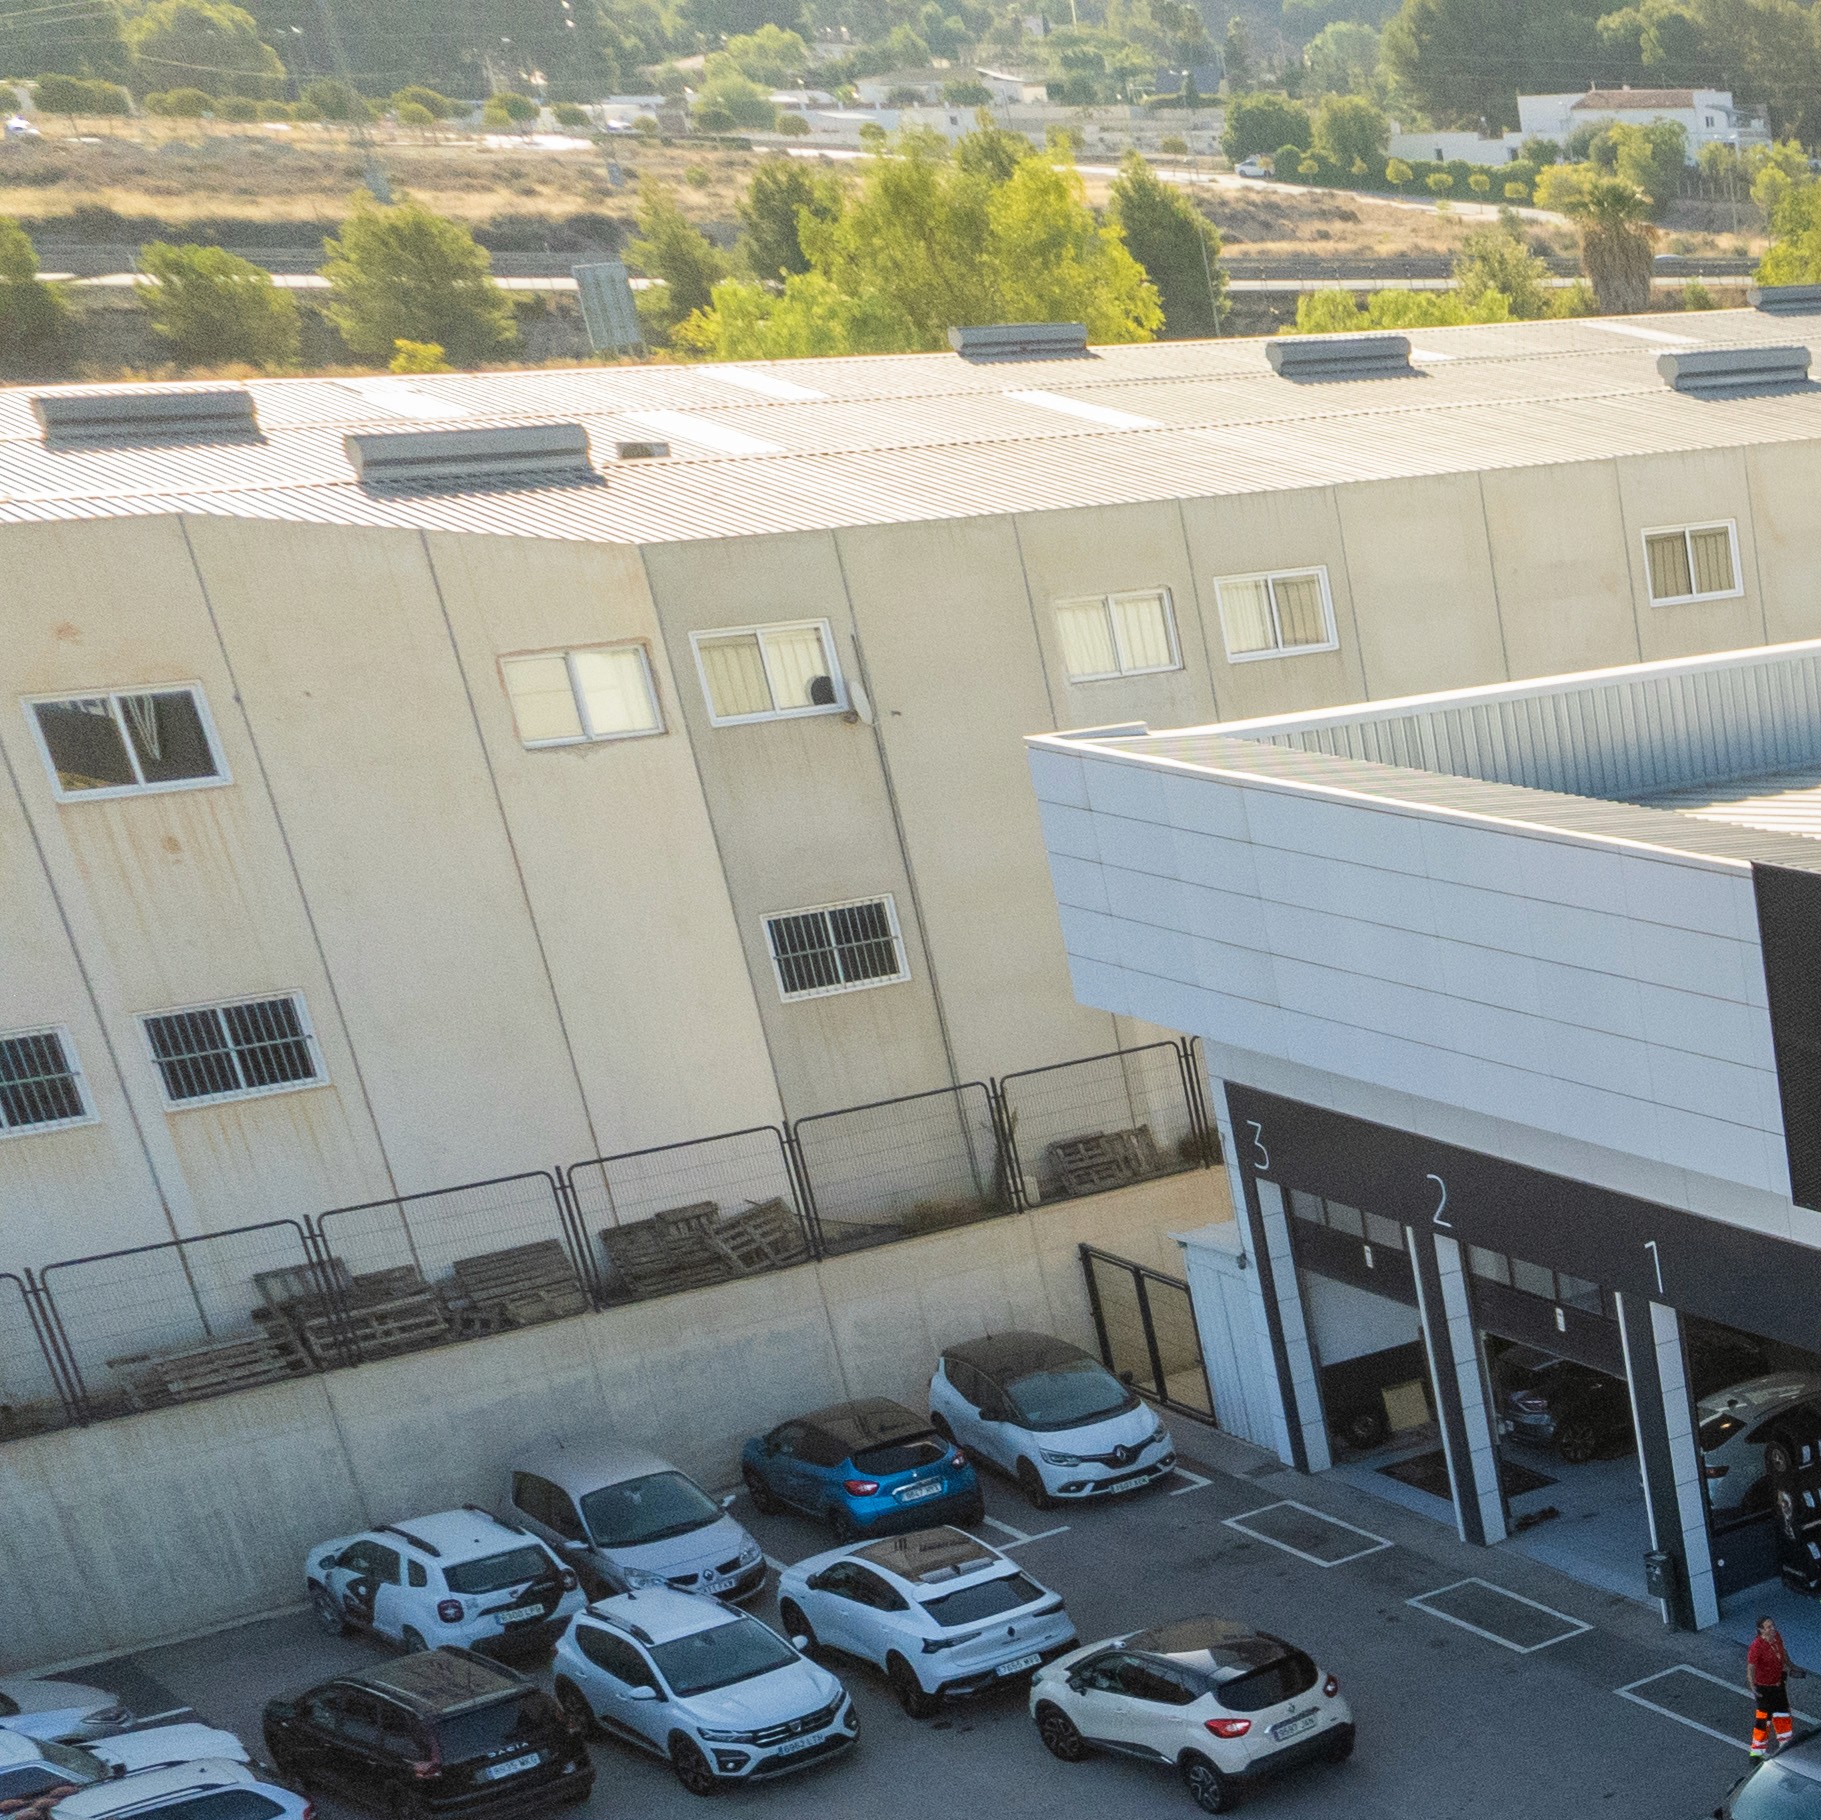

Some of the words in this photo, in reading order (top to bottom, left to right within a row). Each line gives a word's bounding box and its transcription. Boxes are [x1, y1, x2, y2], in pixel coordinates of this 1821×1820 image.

[1247, 1119, 1269, 1170] 3
[1426, 1173, 1452, 1228] 2
[1644, 1241, 1663, 1294] 1
